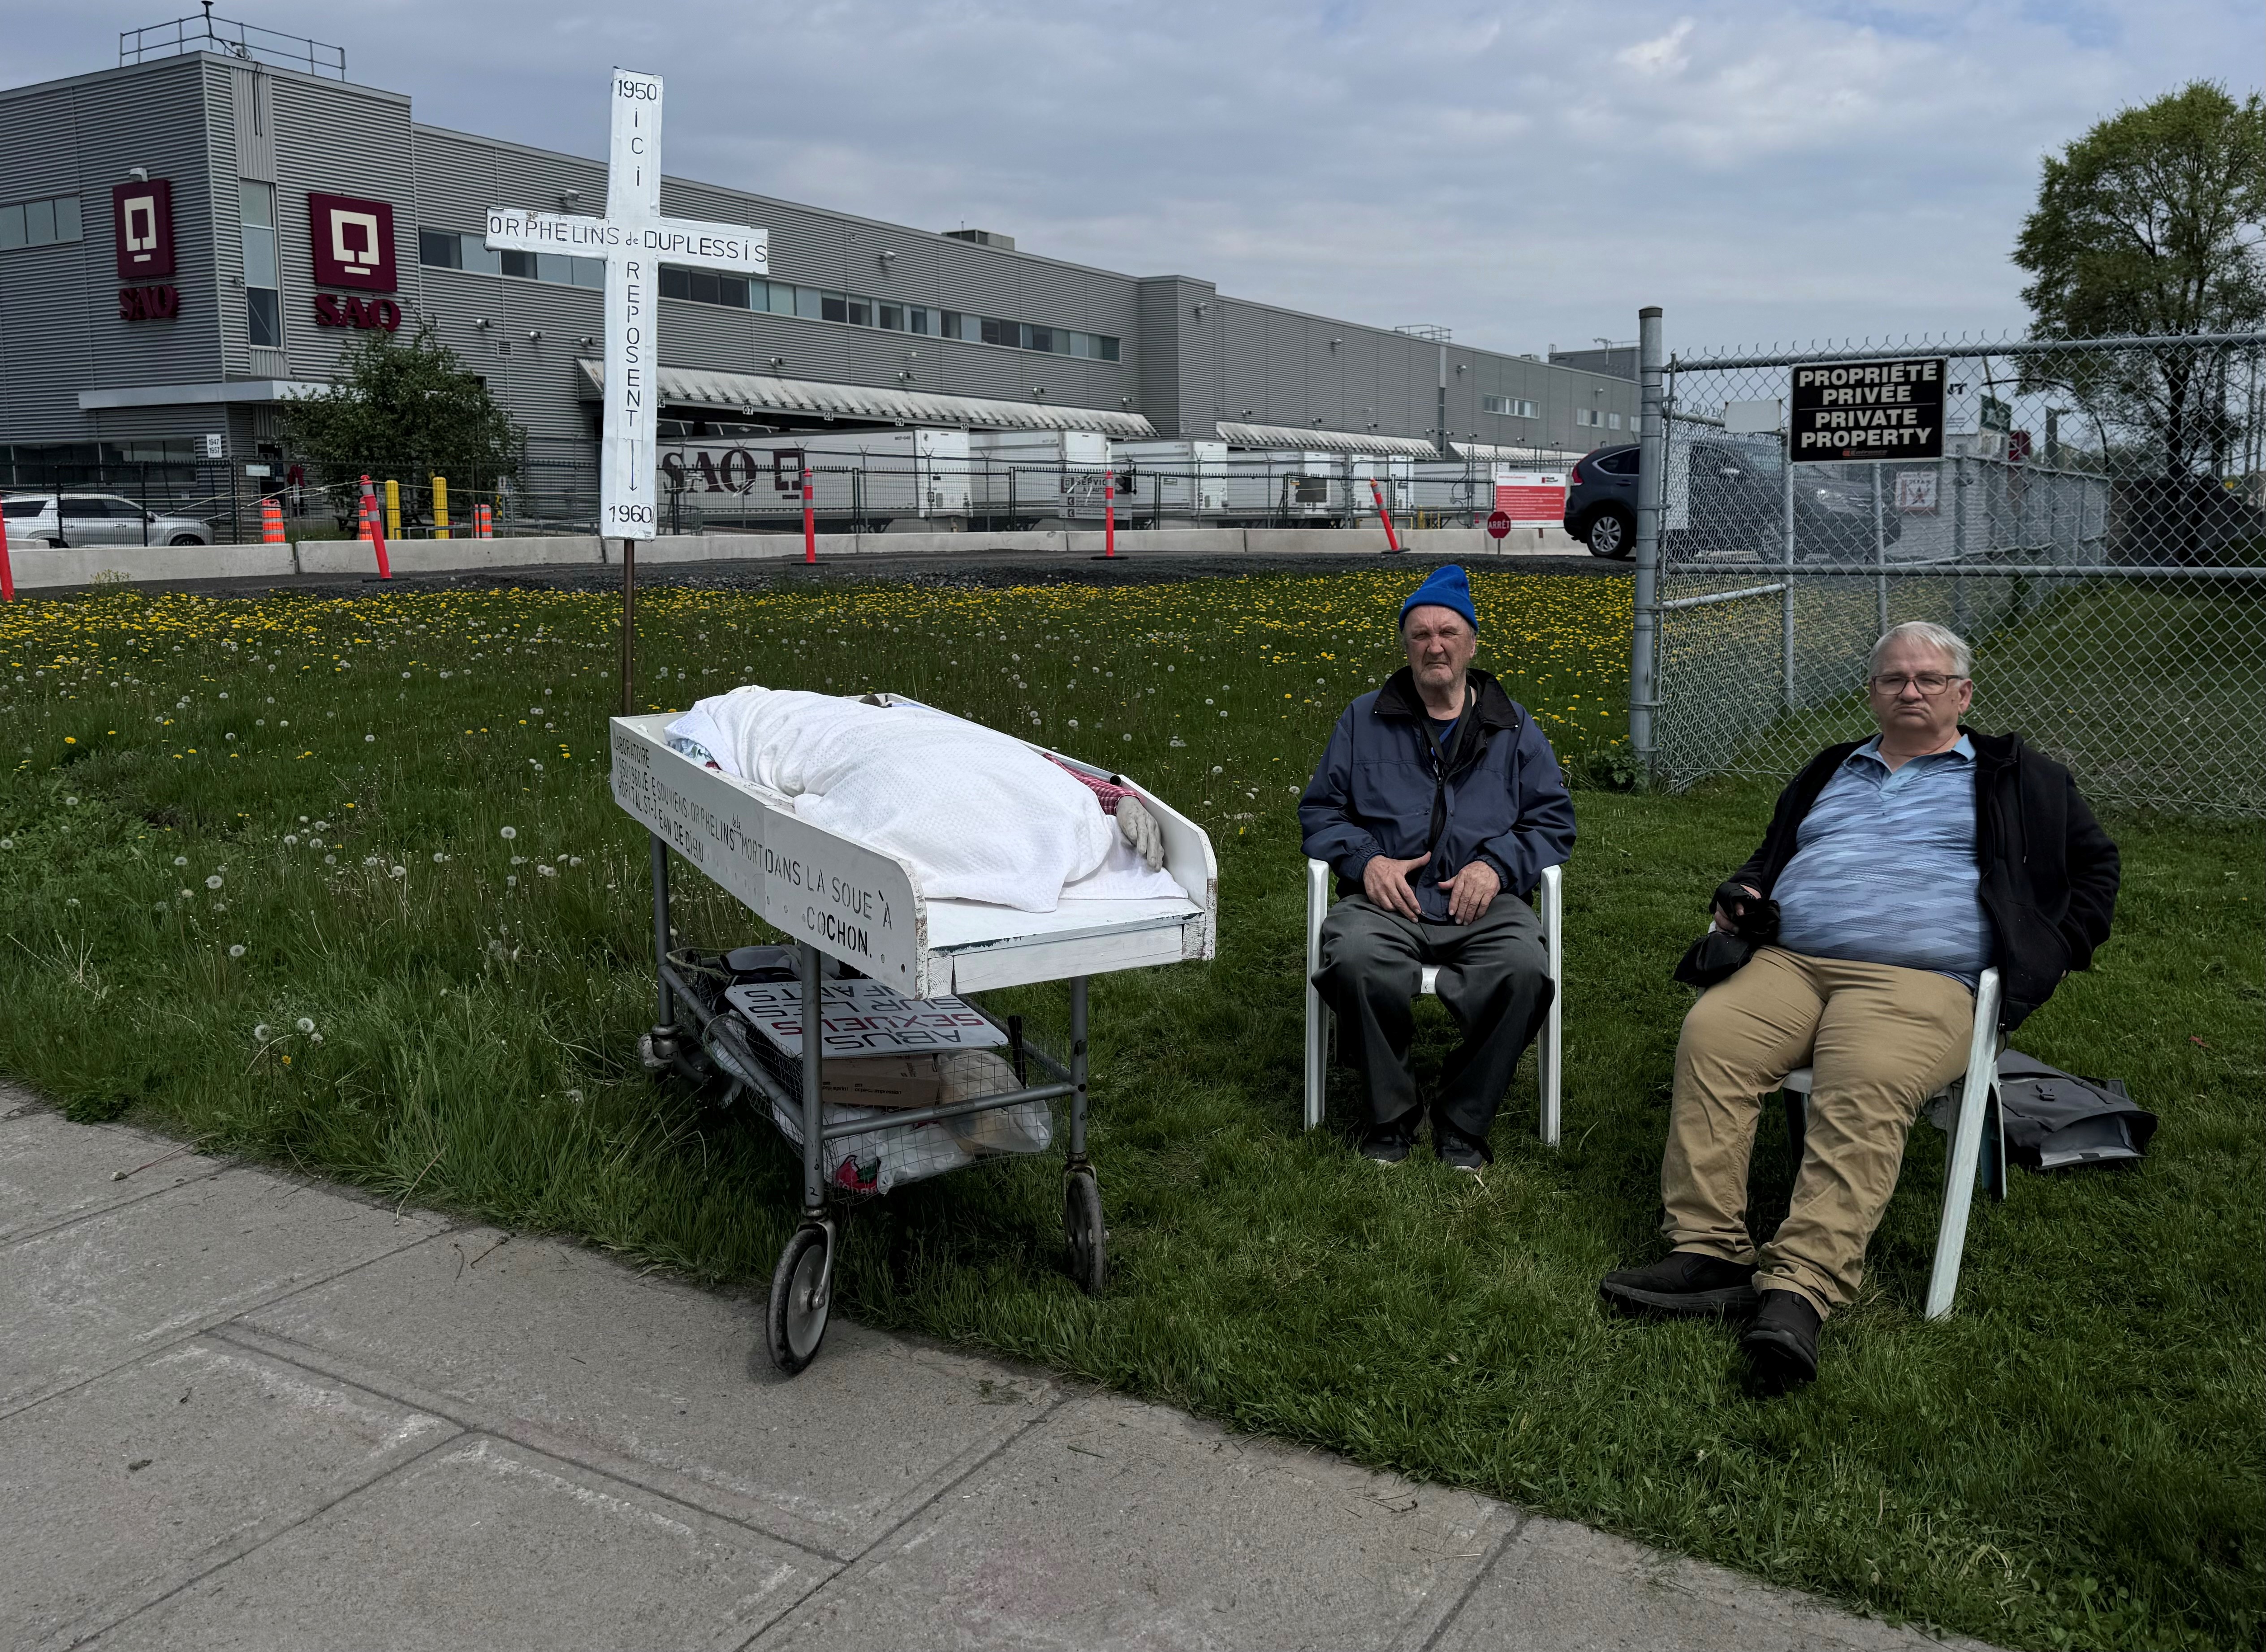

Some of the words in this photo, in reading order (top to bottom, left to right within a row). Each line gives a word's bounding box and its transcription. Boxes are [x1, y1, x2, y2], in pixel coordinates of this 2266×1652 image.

[618, 80, 657, 100] 1950
[490, 216, 620, 245] ORPHELINS
[626, 231, 639, 246] de
[118, 284, 179, 321] SAQ
[315, 293, 401, 332] SAQ
[1799, 361, 1938, 387] PROPRIÉTÉ
[1822, 383, 1912, 405] PRIVÉE
[1815, 408, 1918, 428] PRIVATE
[1801, 427, 1933, 448] PROPERTY
[662, 449, 757, 496] SAQ
[609, 505, 652, 523] 1960
[1488, 519, 1511, 529] ARRÊT
[691, 802, 734, 851] ORPHELINS
[741, 833, 763, 868] MORT
[765, 848, 801, 886] DANS
[807, 865, 825, 894] LA
[832, 876, 872, 920] SOUE
[871, 998, 968, 1012] SUR
[824, 1030, 962, 1050] ABUS
